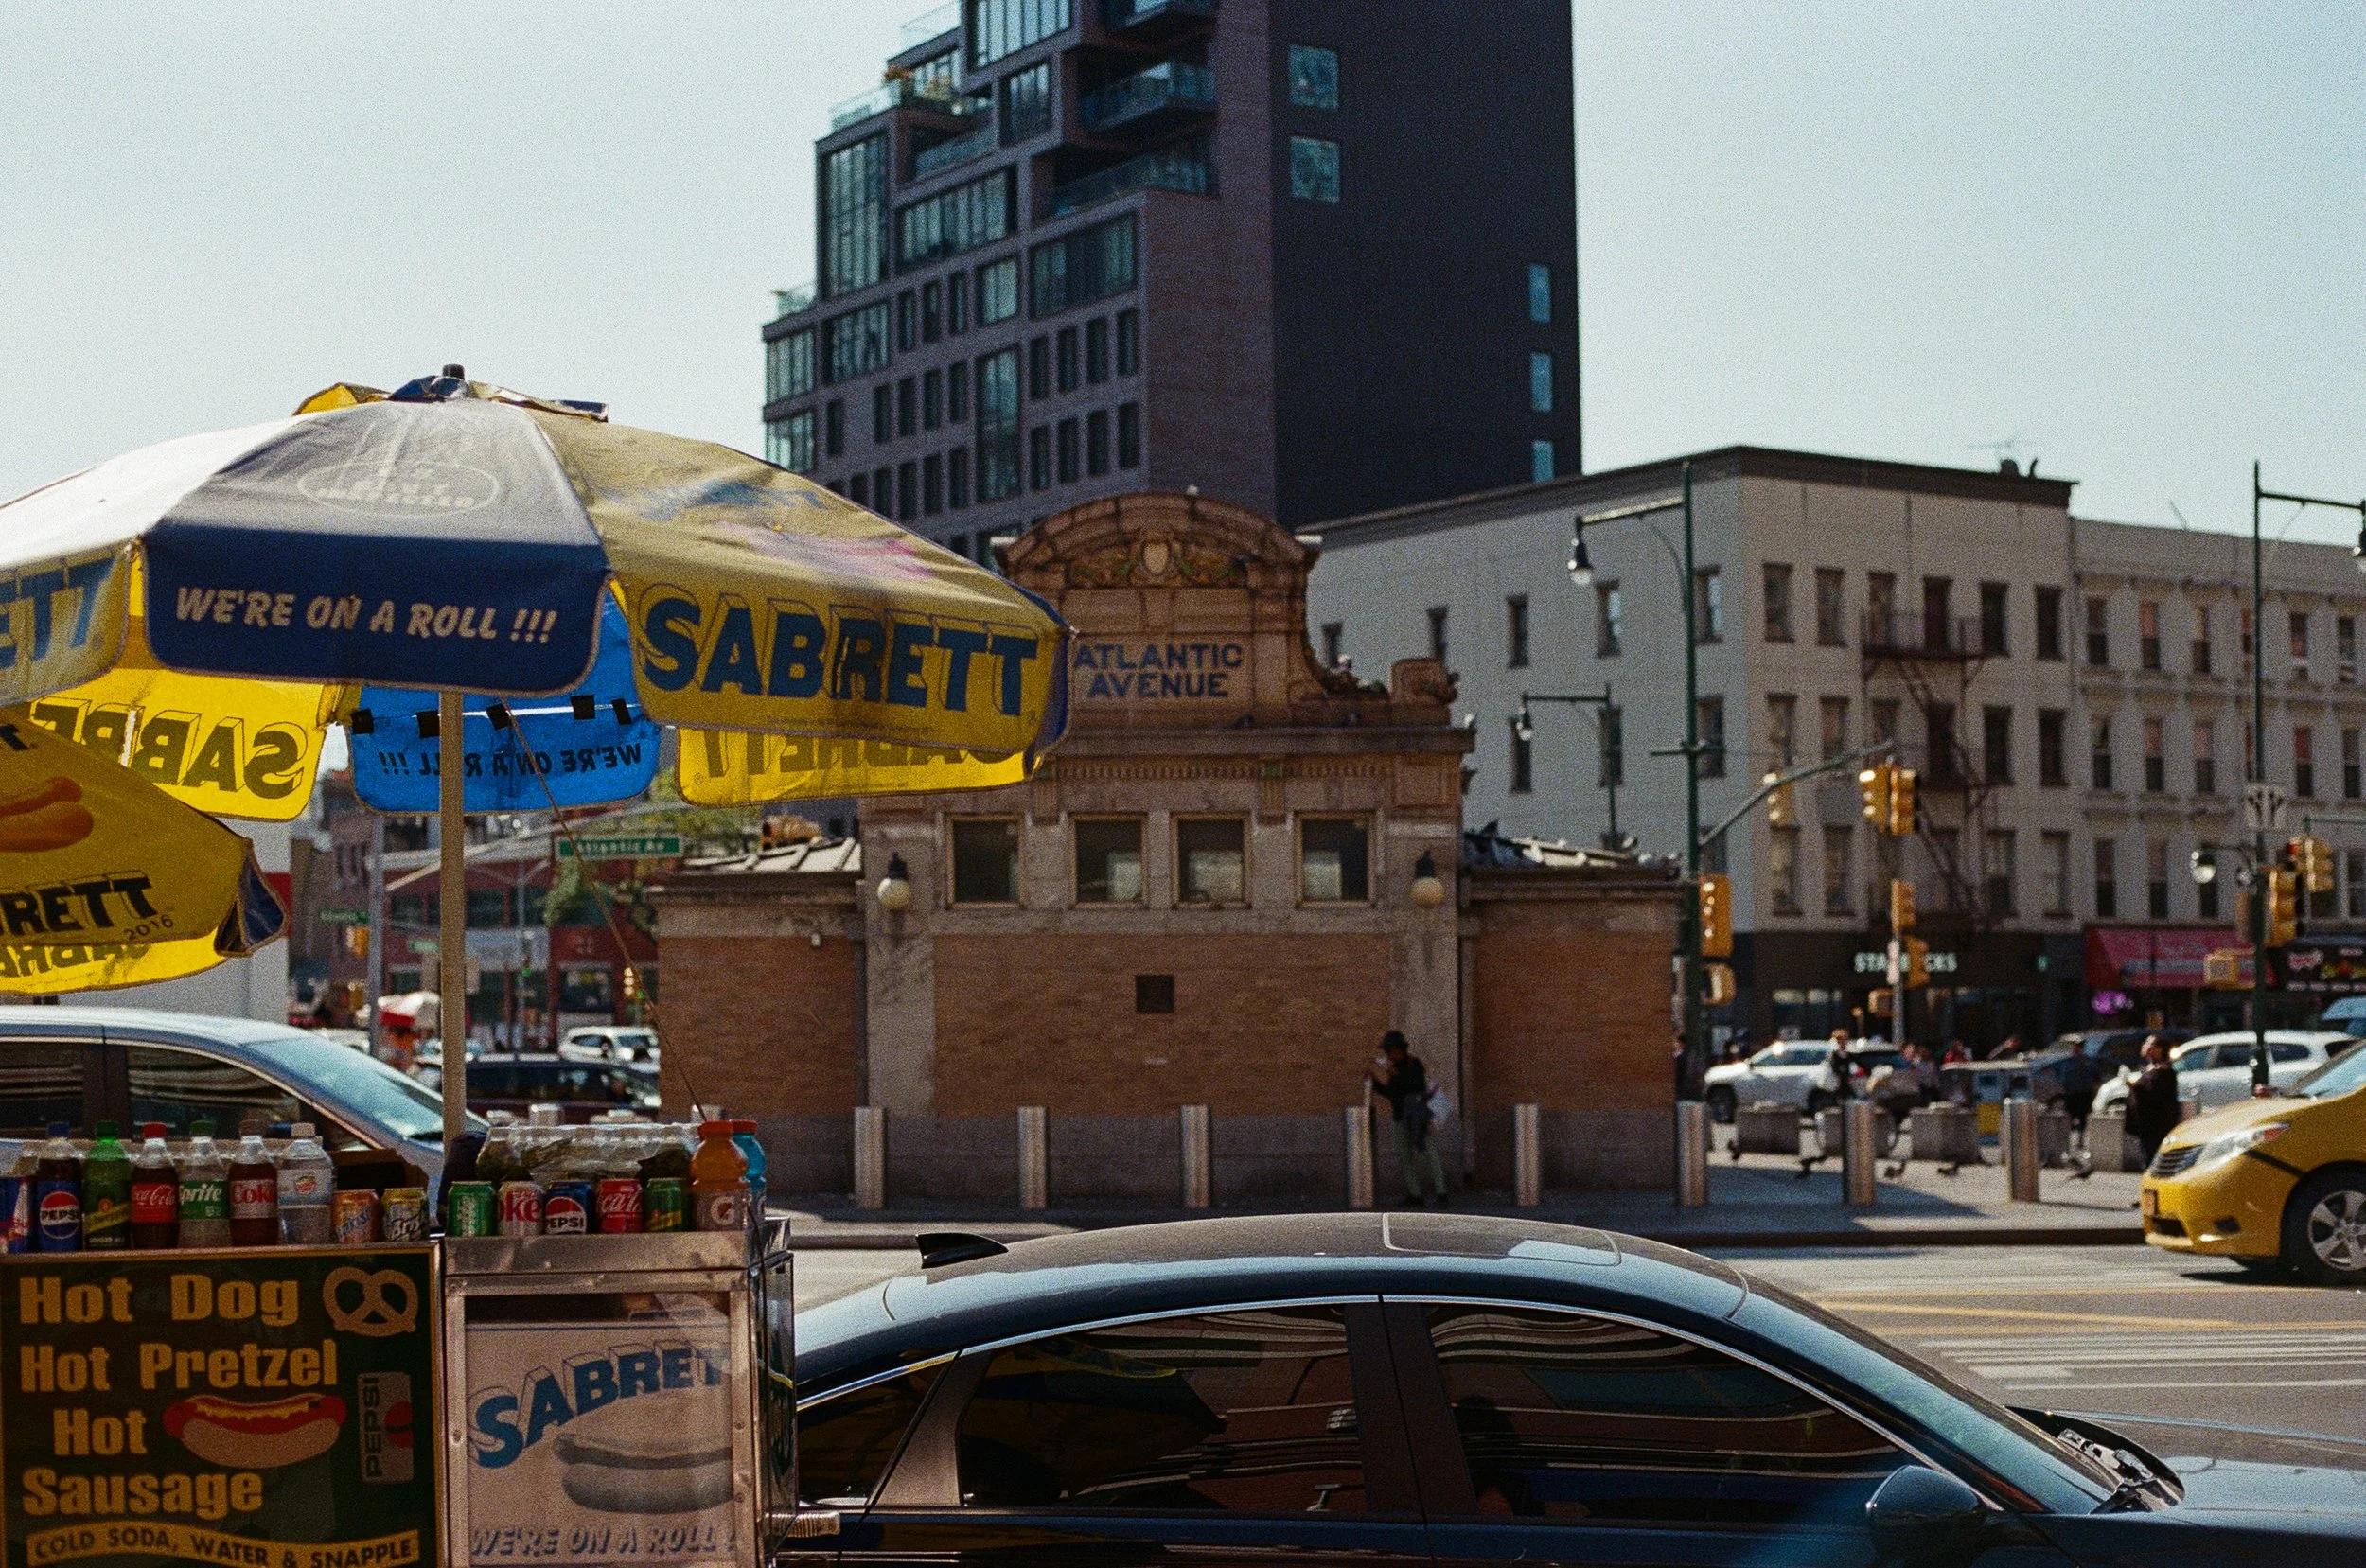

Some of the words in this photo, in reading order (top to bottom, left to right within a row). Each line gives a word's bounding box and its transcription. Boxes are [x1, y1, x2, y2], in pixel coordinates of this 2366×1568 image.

[175, 587, 296, 627] WE'RE
[305, 593, 362, 630] ON
[368, 600, 396, 633] A
[407, 602, 498, 639] ROLL
[509, 608, 558, 643] !!!
[639, 585, 1039, 716] SABRETT
[1074, 643, 1244, 670] ATLANTIC
[1087, 672, 1229, 698] AVENUE
[0, 871, 157, 938] RETT
[124, 916, 174, 941] 2016
[1854, 952, 1958, 974] STABCKS
[711, 1195, 735, 1226] G
[19, 1276, 134, 1325] Hot
[170, 1274, 300, 1327] Dog
[19, 1345, 112, 1393] Hot
[139, 1338, 339, 1390] Pretzel
[52, 1408, 149, 1456] Hot
[362, 1377, 383, 1477] PEPSI
[22, 1467, 265, 1521] Sausage
[34, 1531, 95, 1559] COLD
[106, 1526, 180, 1553] SODA,
[190, 1534, 270, 1566] WATER
[283, 1551, 298, 1567] &
[309, 1537, 415, 1568] SNAPPLE
[472, 1527, 560, 1557] WE'RE
[571, 1526, 611, 1554] ON
[618, 1526, 638, 1554] A
[648, 1526, 718, 1555] ROLL
